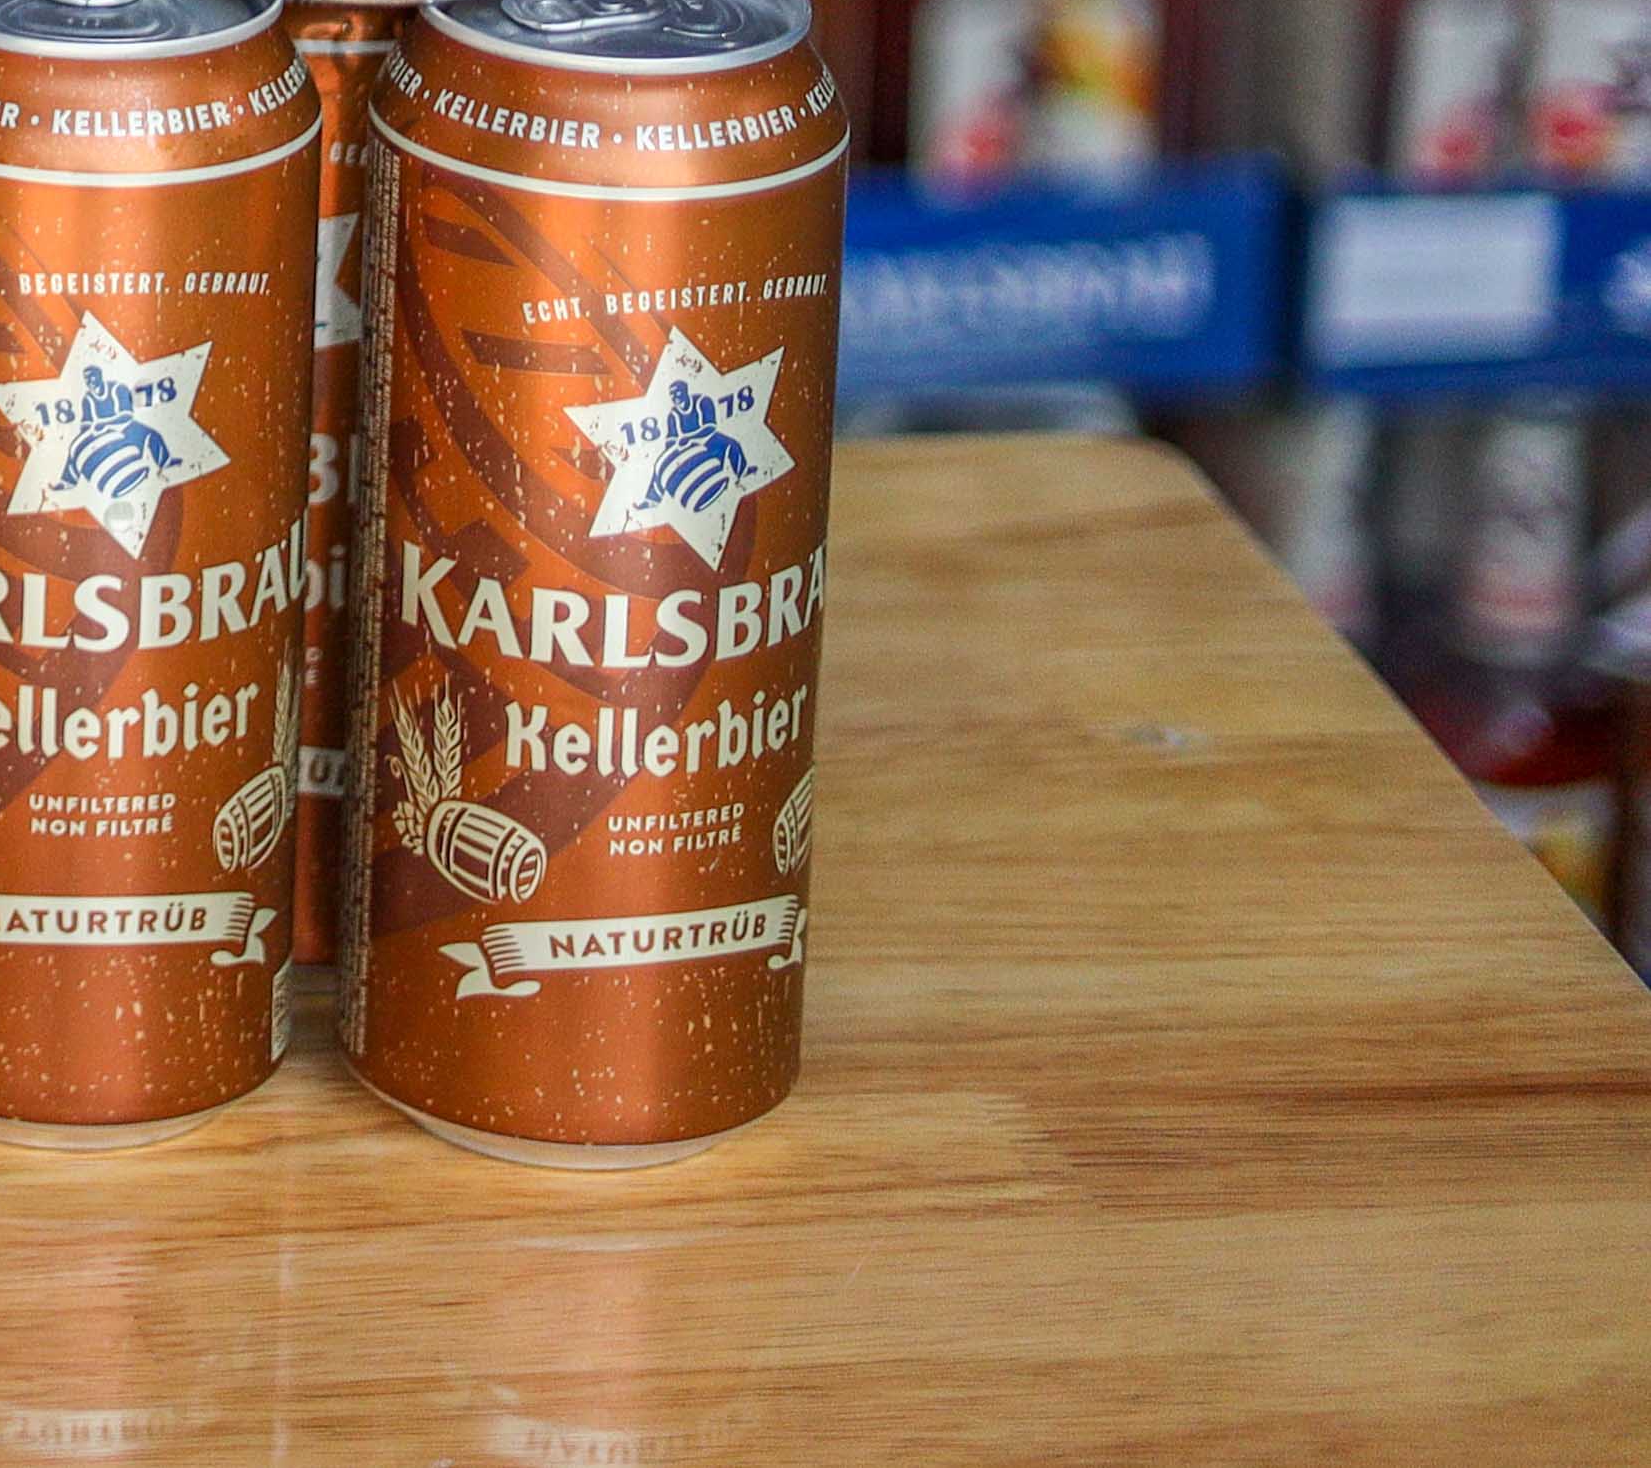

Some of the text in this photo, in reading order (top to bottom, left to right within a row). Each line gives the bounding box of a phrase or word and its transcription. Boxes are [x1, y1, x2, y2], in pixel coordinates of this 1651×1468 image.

[51, 102, 231, 138] KELLERBIER
[434, 89, 600, 149] KELLERBIER
[523, 298, 589, 325] ECHT.
[606, 282, 751, 316] BEGEISTERT.
[34, 376, 177, 426] 18 78
[401, 541, 824, 669] KARLSBRÄ
[505, 684, 807, 780] Kellerbier
[29, 792, 176, 814] UNFILTERED
[31, 813, 173, 836] NON FILTRÉ
[549, 910, 766, 960] NATURTRÜB
